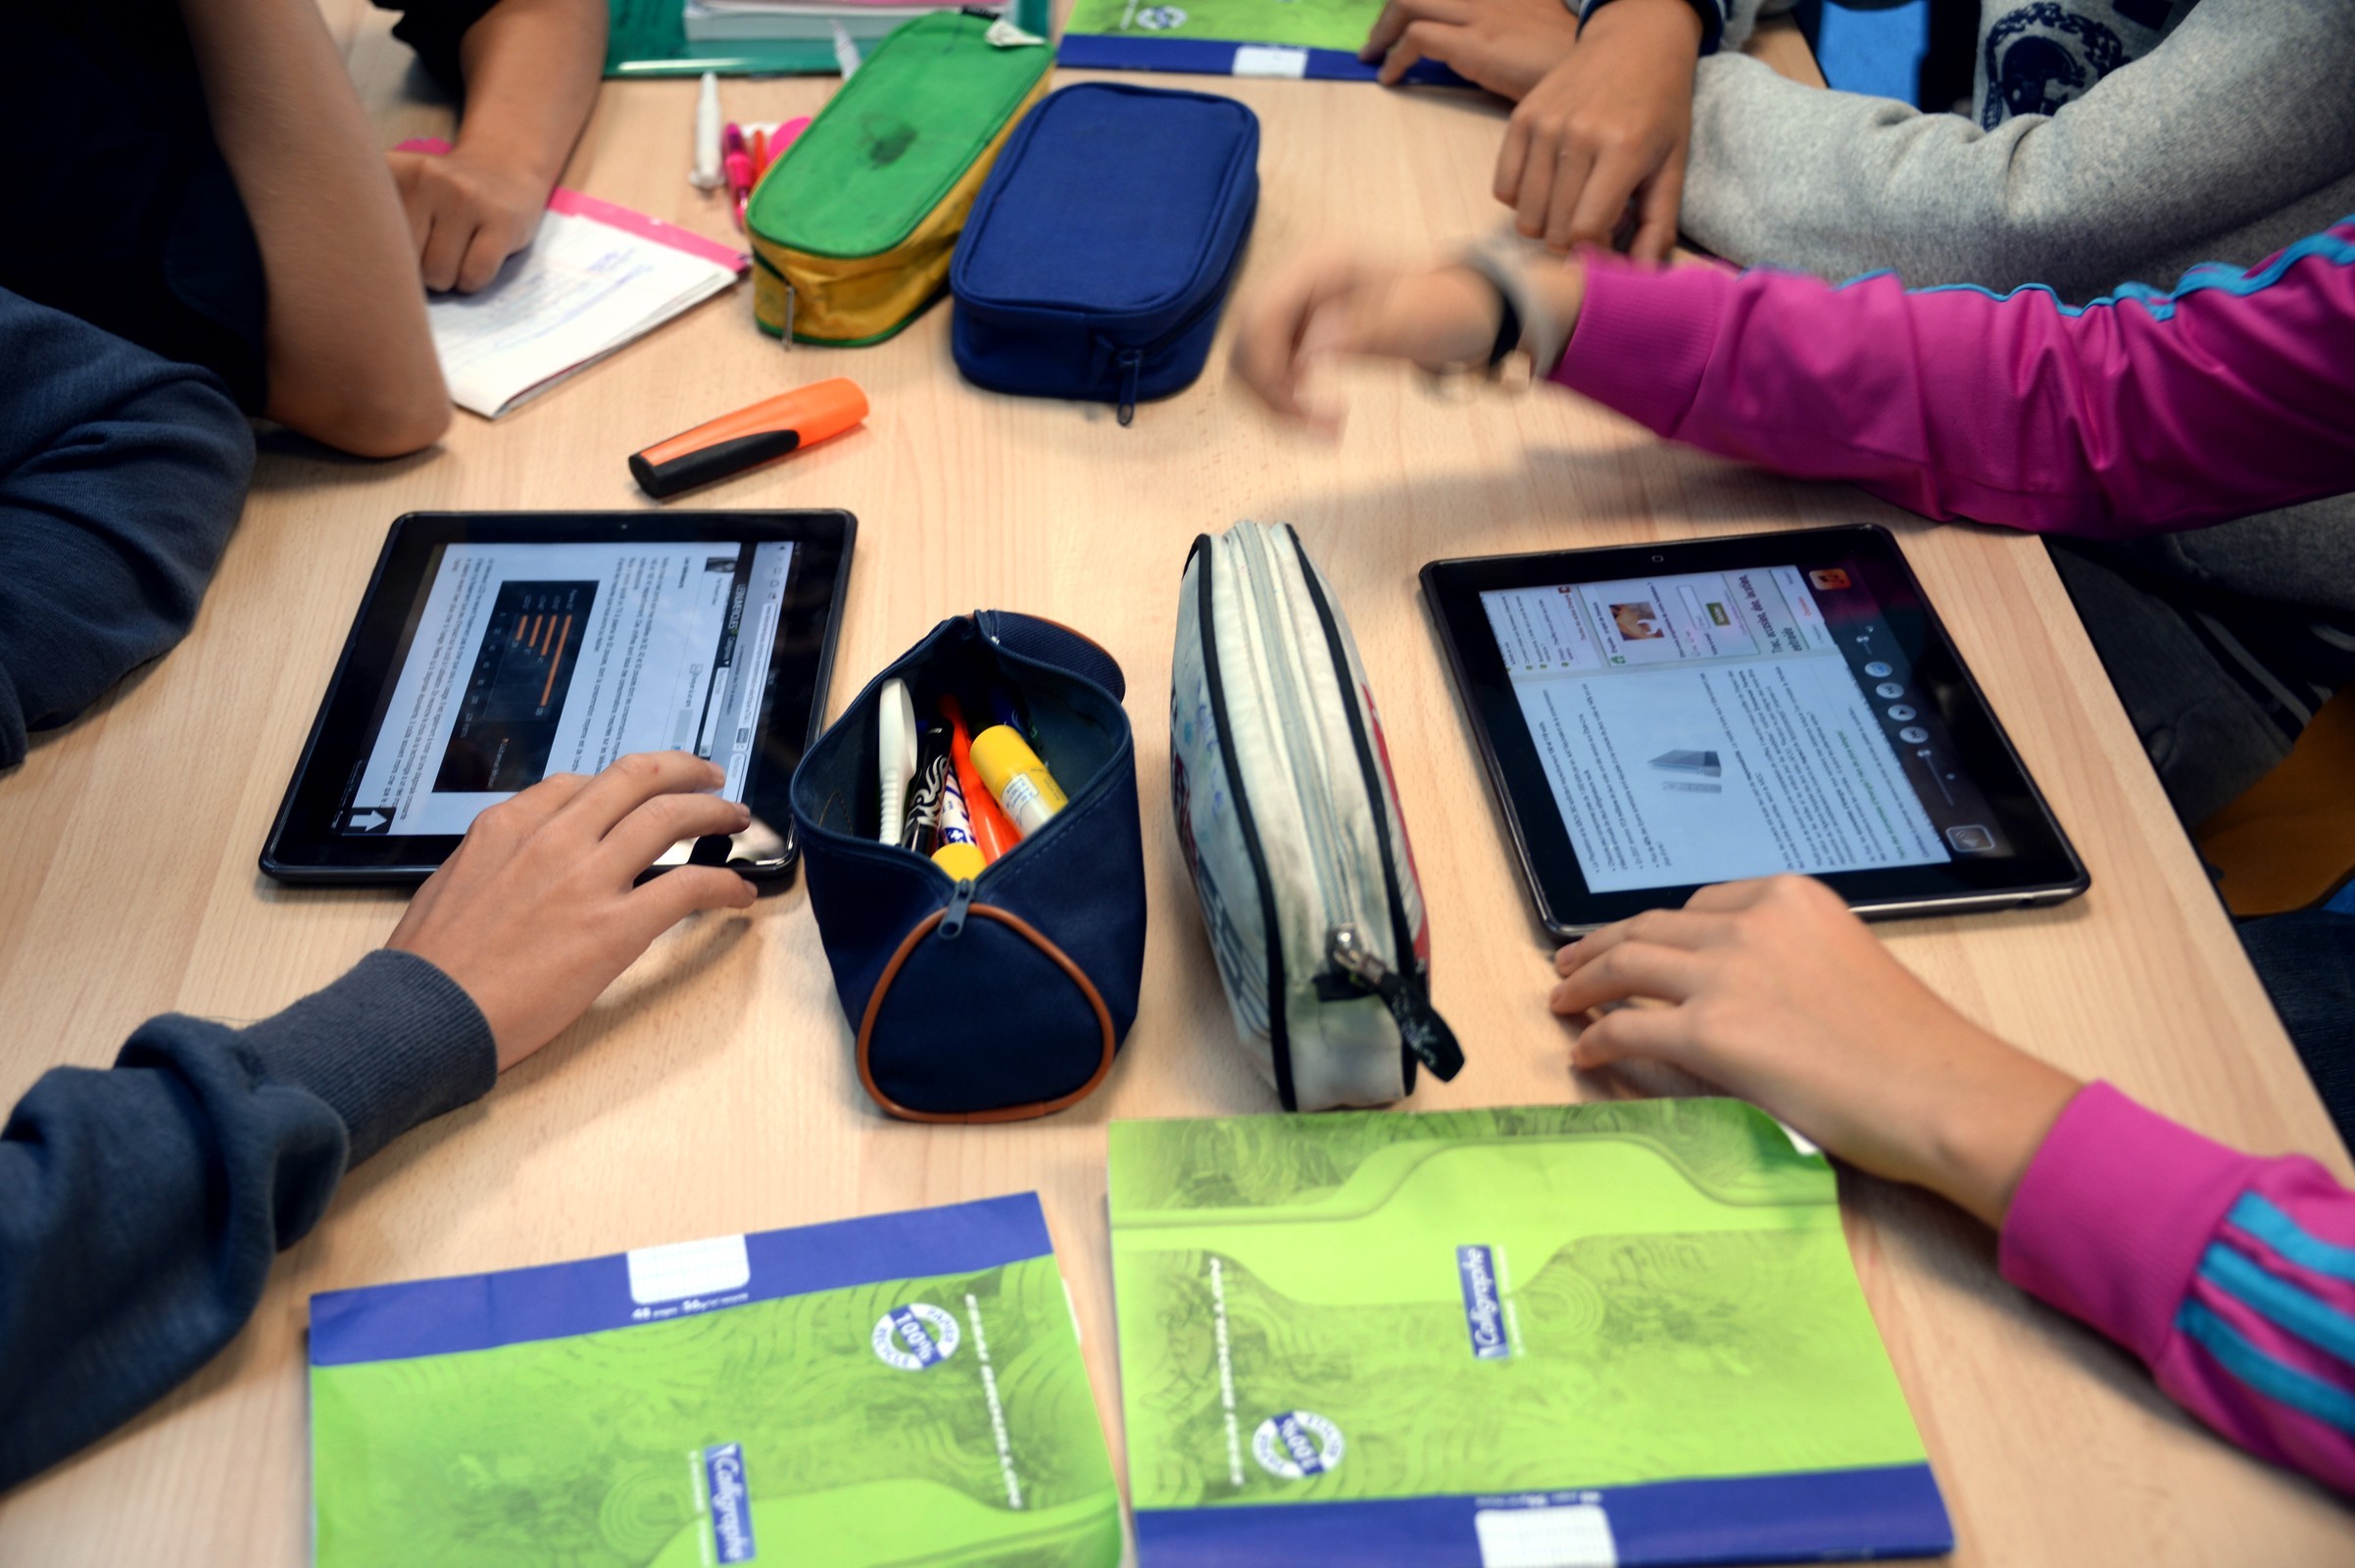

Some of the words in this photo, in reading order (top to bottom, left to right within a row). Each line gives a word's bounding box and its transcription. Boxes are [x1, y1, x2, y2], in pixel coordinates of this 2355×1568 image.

[1462, 1248, 1501, 1347] Calligraphe
[895, 1311, 932, 1363] 100%
[1283, 1417, 1319, 1470] 100%
[711, 1457, 748, 1560] Calligraphe
